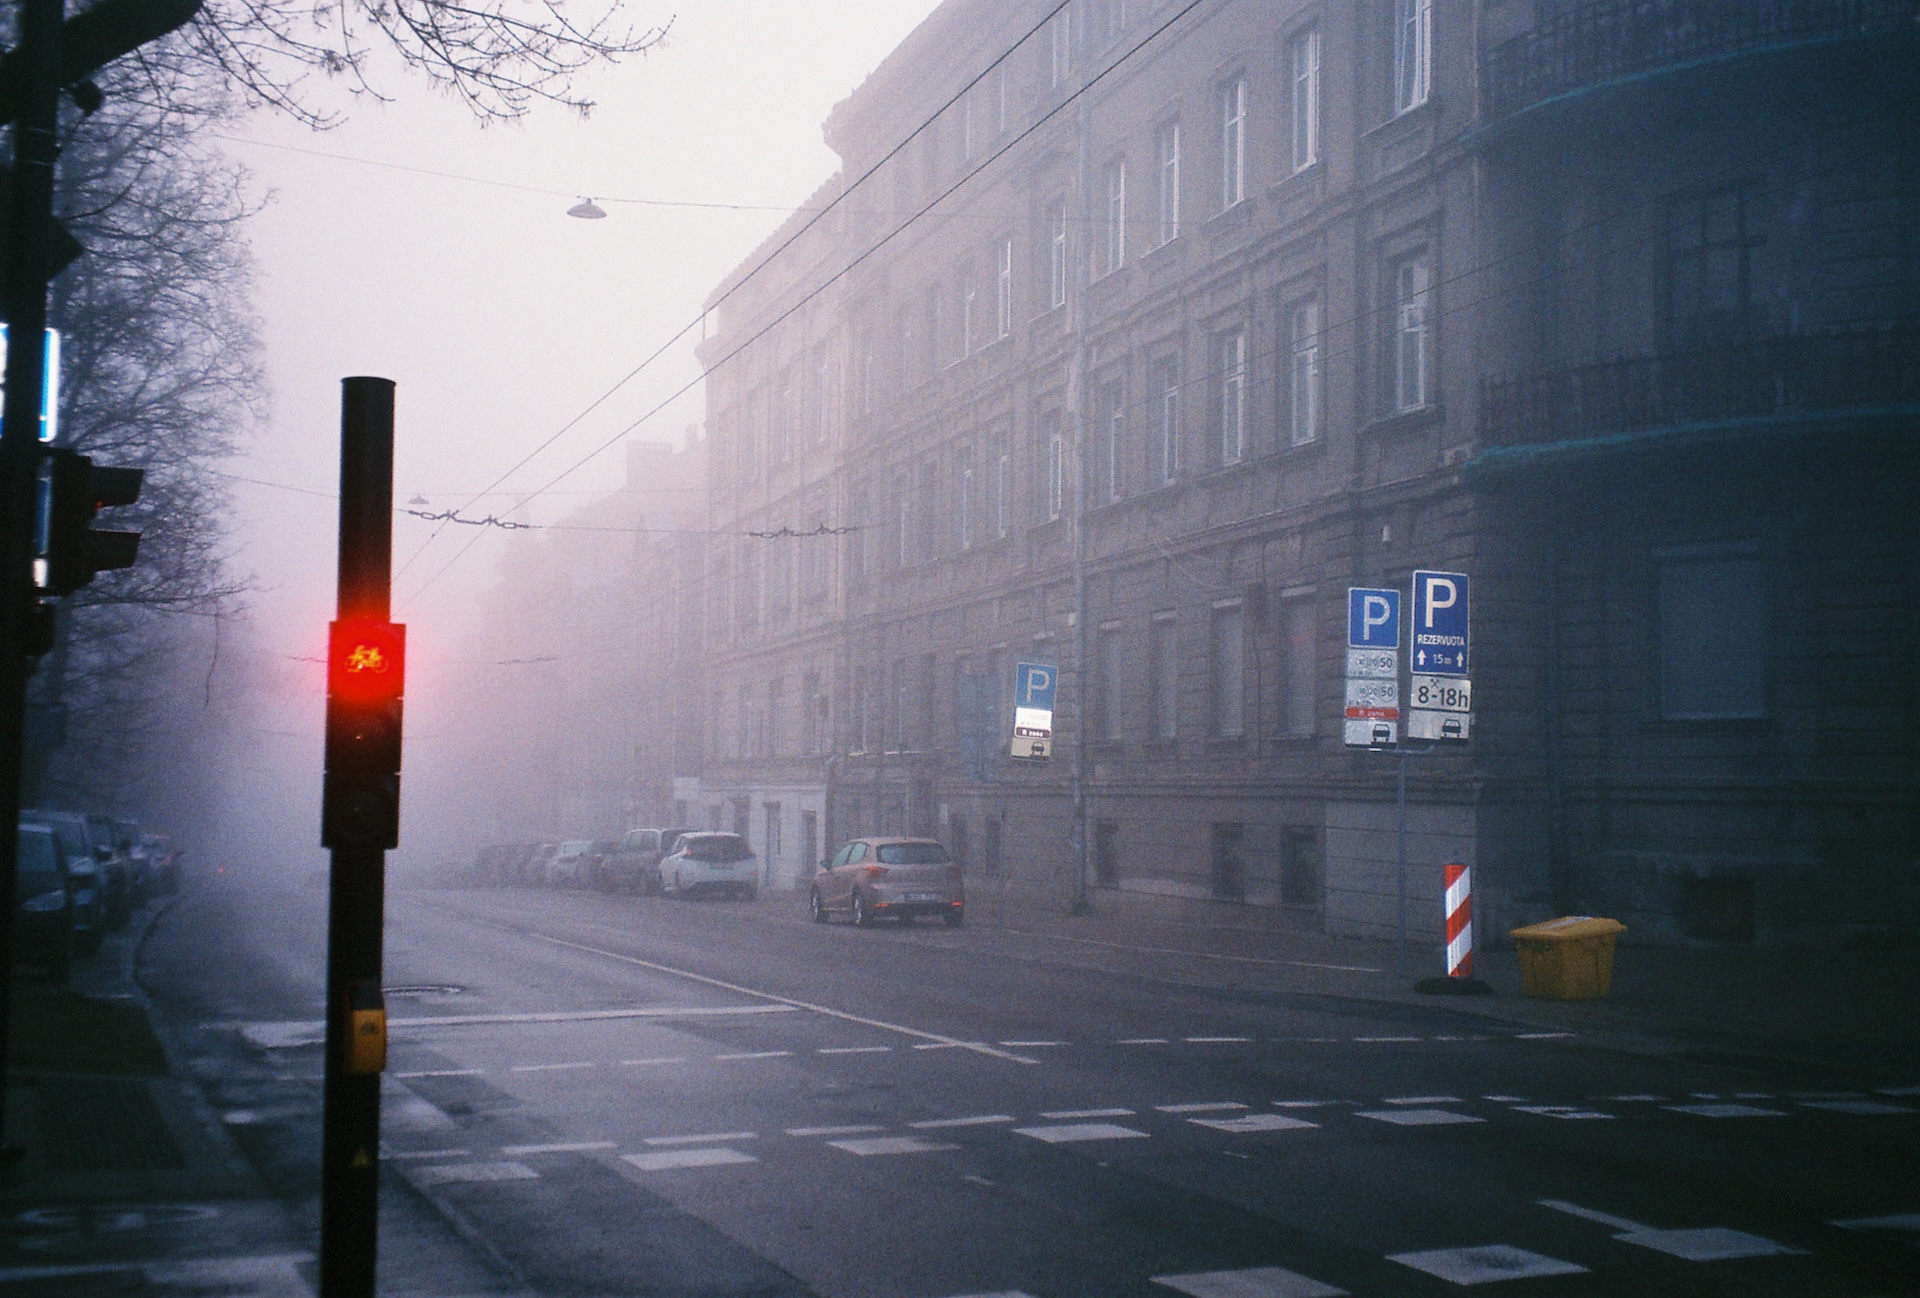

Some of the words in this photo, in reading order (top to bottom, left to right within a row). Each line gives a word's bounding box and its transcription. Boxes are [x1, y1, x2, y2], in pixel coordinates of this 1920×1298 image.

[1426, 578, 1457, 627] P
[1364, 596, 1390, 640] P
[1417, 634, 1465, 646] REZERVUOTA
[1380, 657, 1393, 668] 50
[1027, 669, 1050, 702] P
[1381, 686, 1394, 697] 50
[1418, 686, 1468, 708] 8-18h
